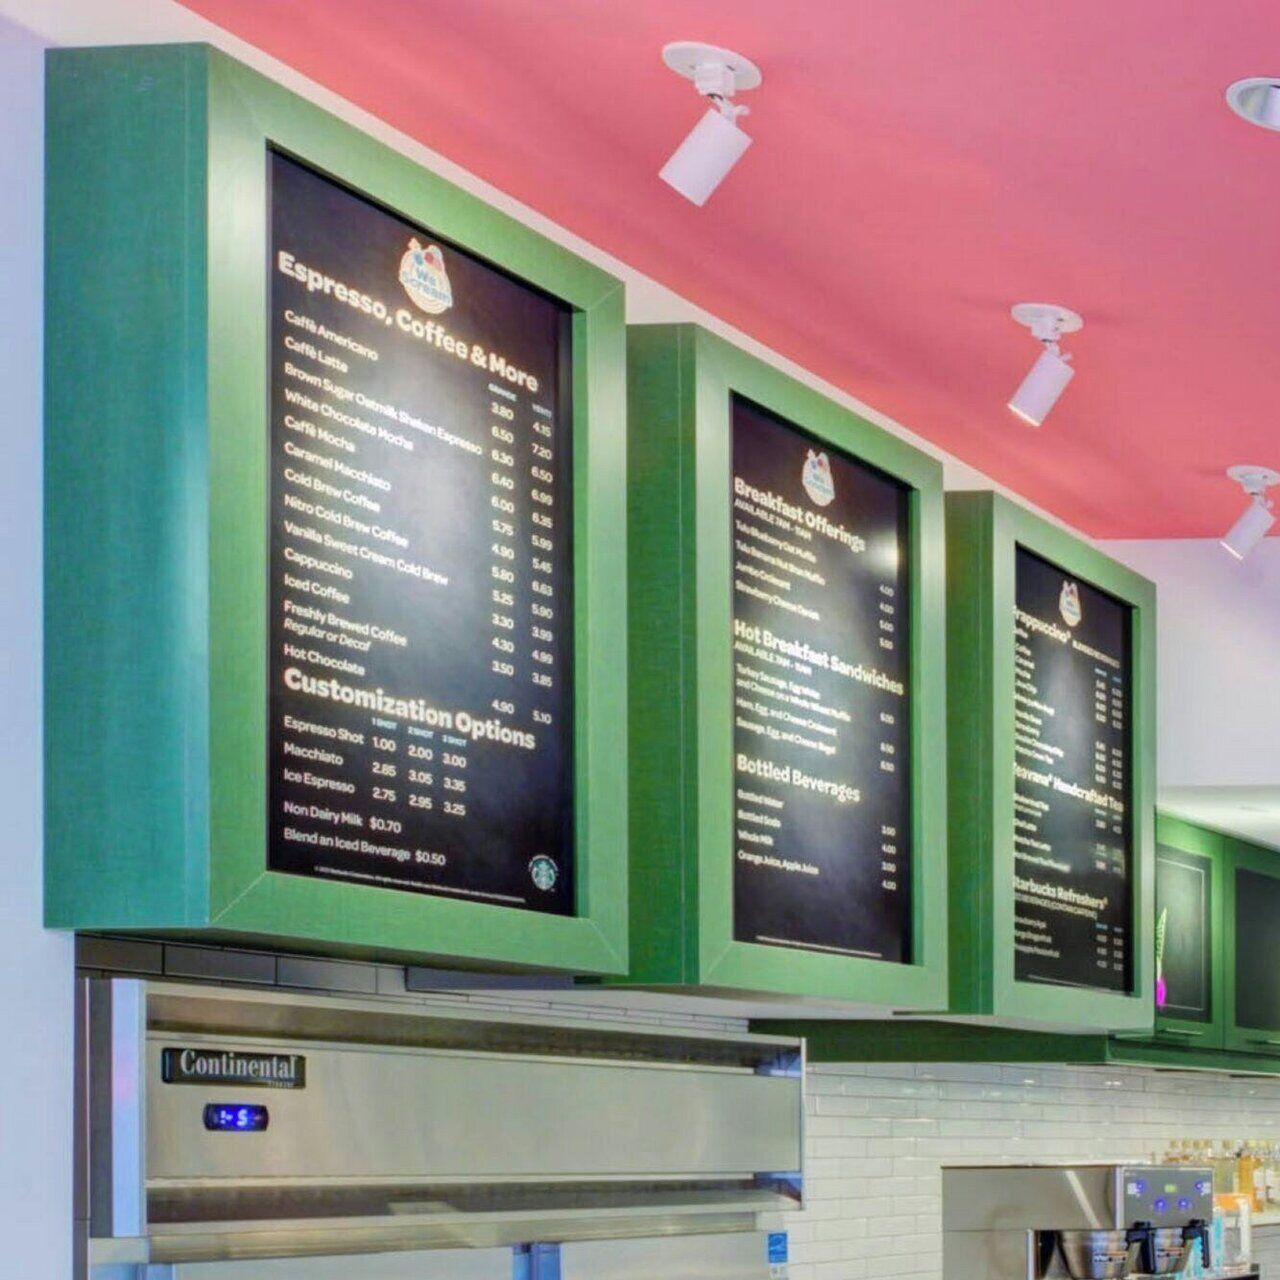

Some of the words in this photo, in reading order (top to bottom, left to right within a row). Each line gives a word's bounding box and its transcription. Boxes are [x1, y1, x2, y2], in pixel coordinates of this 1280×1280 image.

[278, 250, 394, 326] Espresso,
[396, 308, 468, 360] Coffee
[470, 344, 488, 368] &
[489, 352, 539, 392] More
[317, 325, 379, 361] Americano
[284, 362, 322, 388] Brown
[322, 378, 354, 401] Sugar
[318, 351, 349, 373] Latte
[284, 388, 319, 412] White
[320, 404, 377, 436] Chocolate
[378, 427, 414, 451] Mocha
[318, 427, 356, 453] Mocha
[284, 442, 333, 469] Caramel
[334, 460, 391, 491] Macchiato
[284, 468, 312, 488] Cold
[313, 478, 342, 498] Brew
[343, 490, 381, 513] Coffee
[284, 494, 314, 514] Nitro
[315, 505, 342, 525] Cold
[342, 514, 370, 534] Brew
[372, 525, 410, 549] Coffee
[734, 476, 804, 523] Breakfast
[804, 511, 866, 553] Offerings
[284, 520, 323, 544] Vanilla
[324, 534, 358, 557] Sweet
[359, 546, 396, 569] Cream
[397, 559, 422, 576] Cold
[422, 566, 449, 587] Brew
[284, 547, 353, 580] Cappuccino
[284, 573, 310, 592] Iced
[311, 582, 350, 604] Coffee
[284, 600, 326, 624] Freshly
[327, 612, 369, 635] Brewed
[370, 626, 408, 648] Coffee
[284, 618, 326, 636] Regular
[326, 631, 337, 641] or
[338, 634, 371, 652] Decaf
[284, 643, 306, 660] Hot
[307, 650, 366, 676] Chocolate
[734, 618, 761, 644] Hot
[763, 630, 829, 669] Breakfast
[830, 656, 904, 696] Sandwiches
[284, 667, 453, 728] Customization
[455, 712, 536, 749] Options
[284, 715, 336, 738] Espresso
[338, 728, 364, 745] Shot
[372, 736, 396, 752] 1.00
[408, 744, 433, 760] 2.00
[284, 742, 343, 766] Macchiato
[408, 770, 433, 785] 3.05
[737, 754, 790, 783] Bottled
[792, 769, 860, 802] Beverages
[284, 768, 302, 783] Ice
[304, 772, 355, 794] Espresso
[372, 787, 397, 802] 2.75
[408, 795, 433, 810] 2.95
[443, 802, 466, 816] 3.25
[284, 801, 309, 816] Non
[310, 806, 340, 825] Dairy
[341, 811, 363, 827] Milk
[370, 817, 402, 834] $0.70
[284, 828, 318, 844] Blend
[319, 836, 334, 847] an
[335, 836, 360, 852] Iced
[360, 841, 411, 862] Beverage
[414, 850, 447, 866] $0.50
[180, 1050, 297, 1079] Continental
